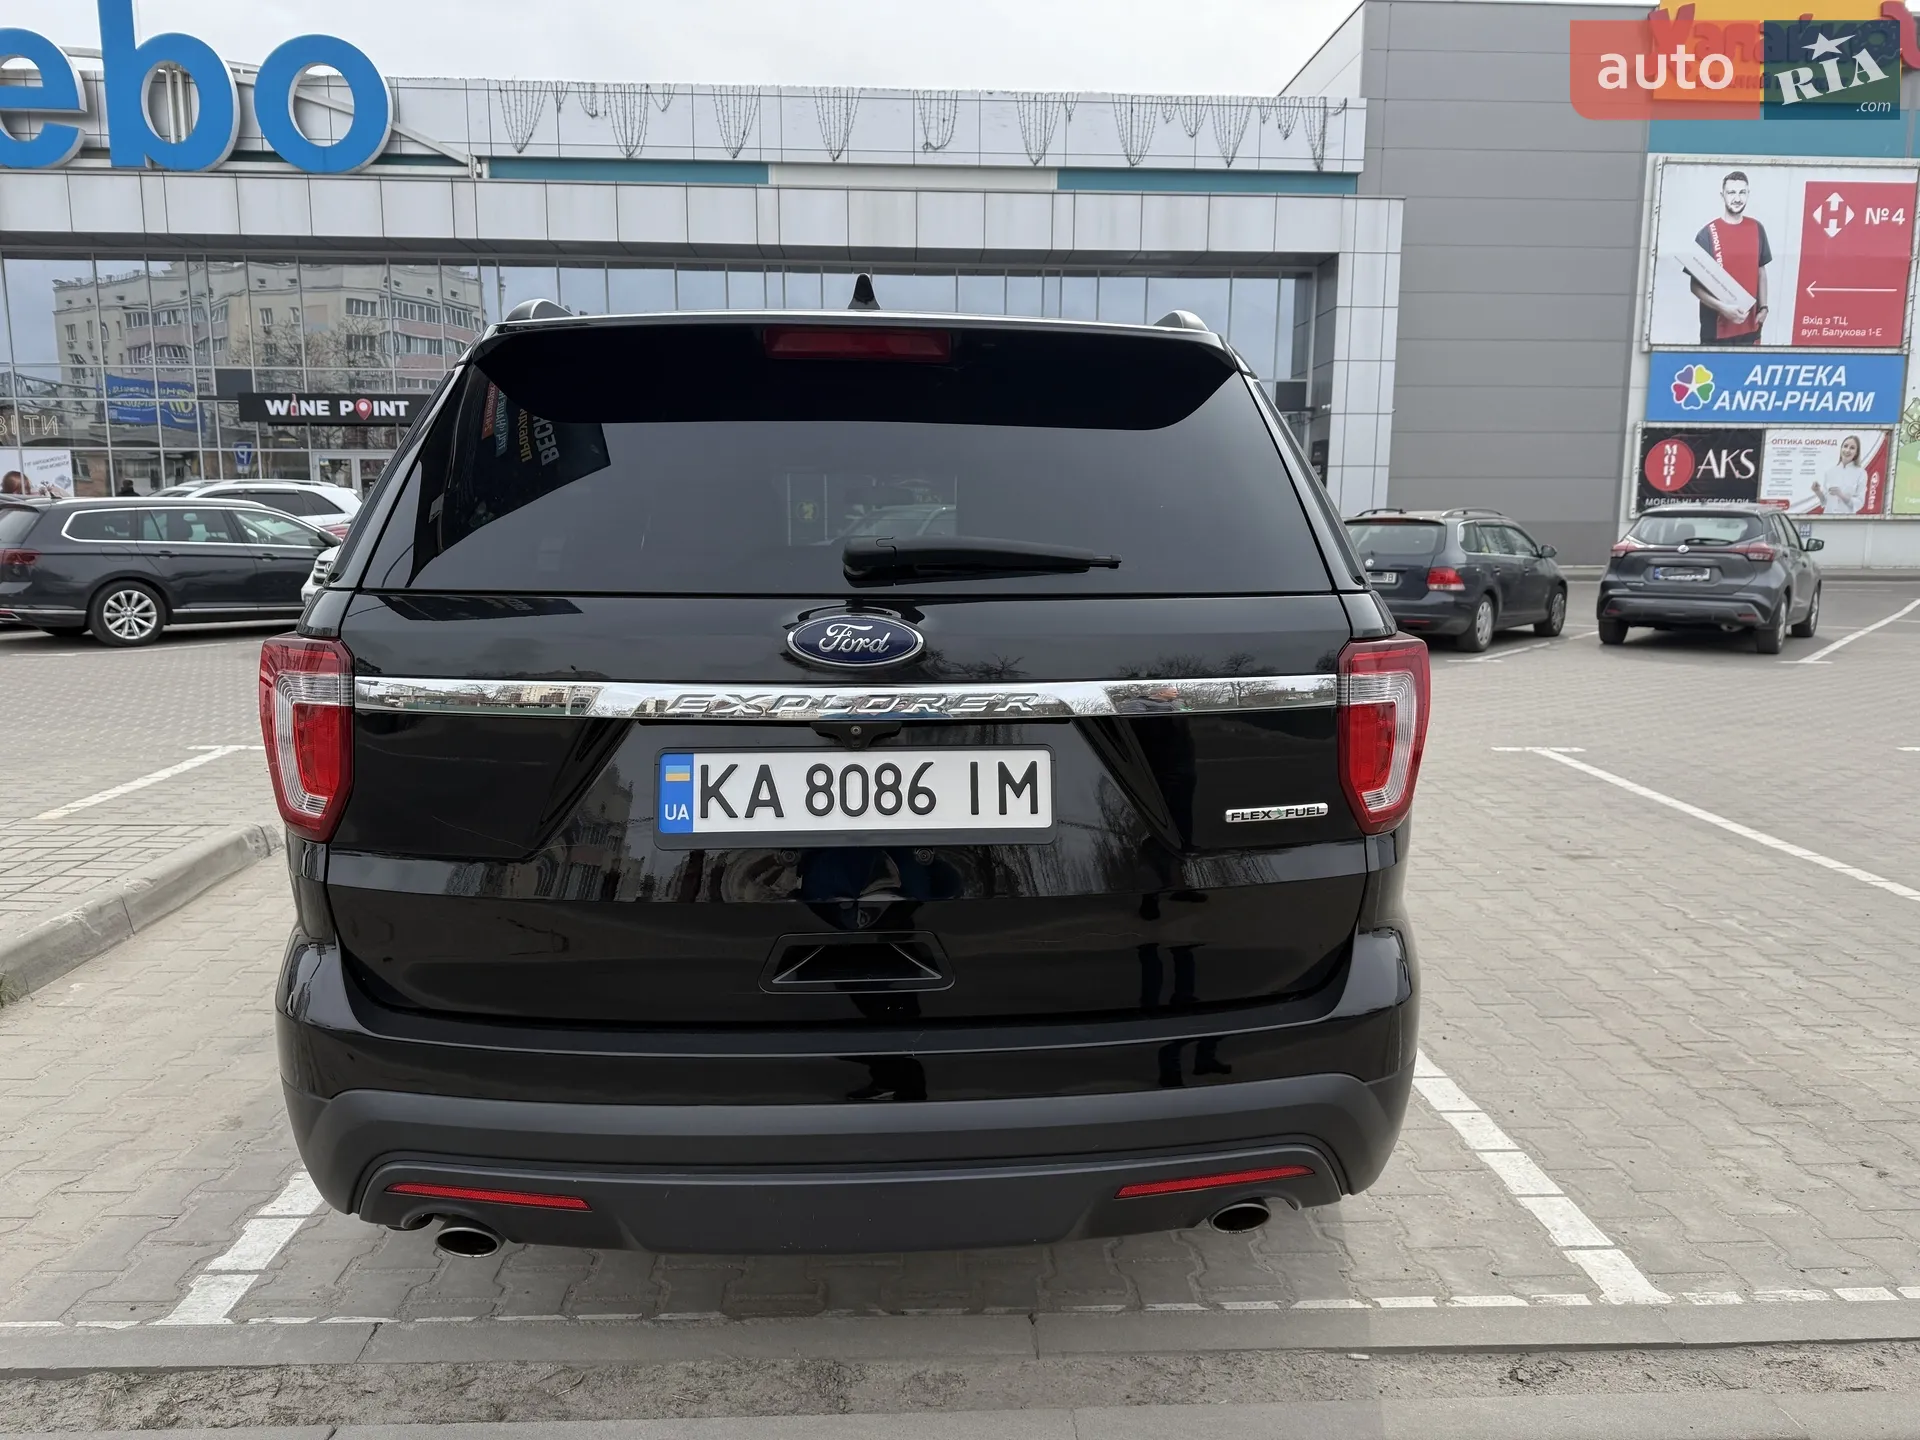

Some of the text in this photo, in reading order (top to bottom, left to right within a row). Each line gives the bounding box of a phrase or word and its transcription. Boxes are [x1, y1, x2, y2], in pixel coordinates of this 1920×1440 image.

[1802, 315, 1823, 325] Вхід
[1801, 328, 1820, 338] вул.
[1822, 327, 1867, 338] Балукова
[1744, 364, 1847, 387] АПТЕКА
[265, 394, 409, 420] WINE POINT
[1713, 390, 1876, 412] ANRI-PHARM
[1805, 438, 1838, 446] ОКОМЕД
[1696, 448, 1756, 479] AKS
[818, 623, 891, 655] Ford
[666, 692, 1040, 714] EXPLORER
[664, 761, 1038, 821] UA KA 8086 IM
[1231, 806, 1325, 821] FLEX FUEL
